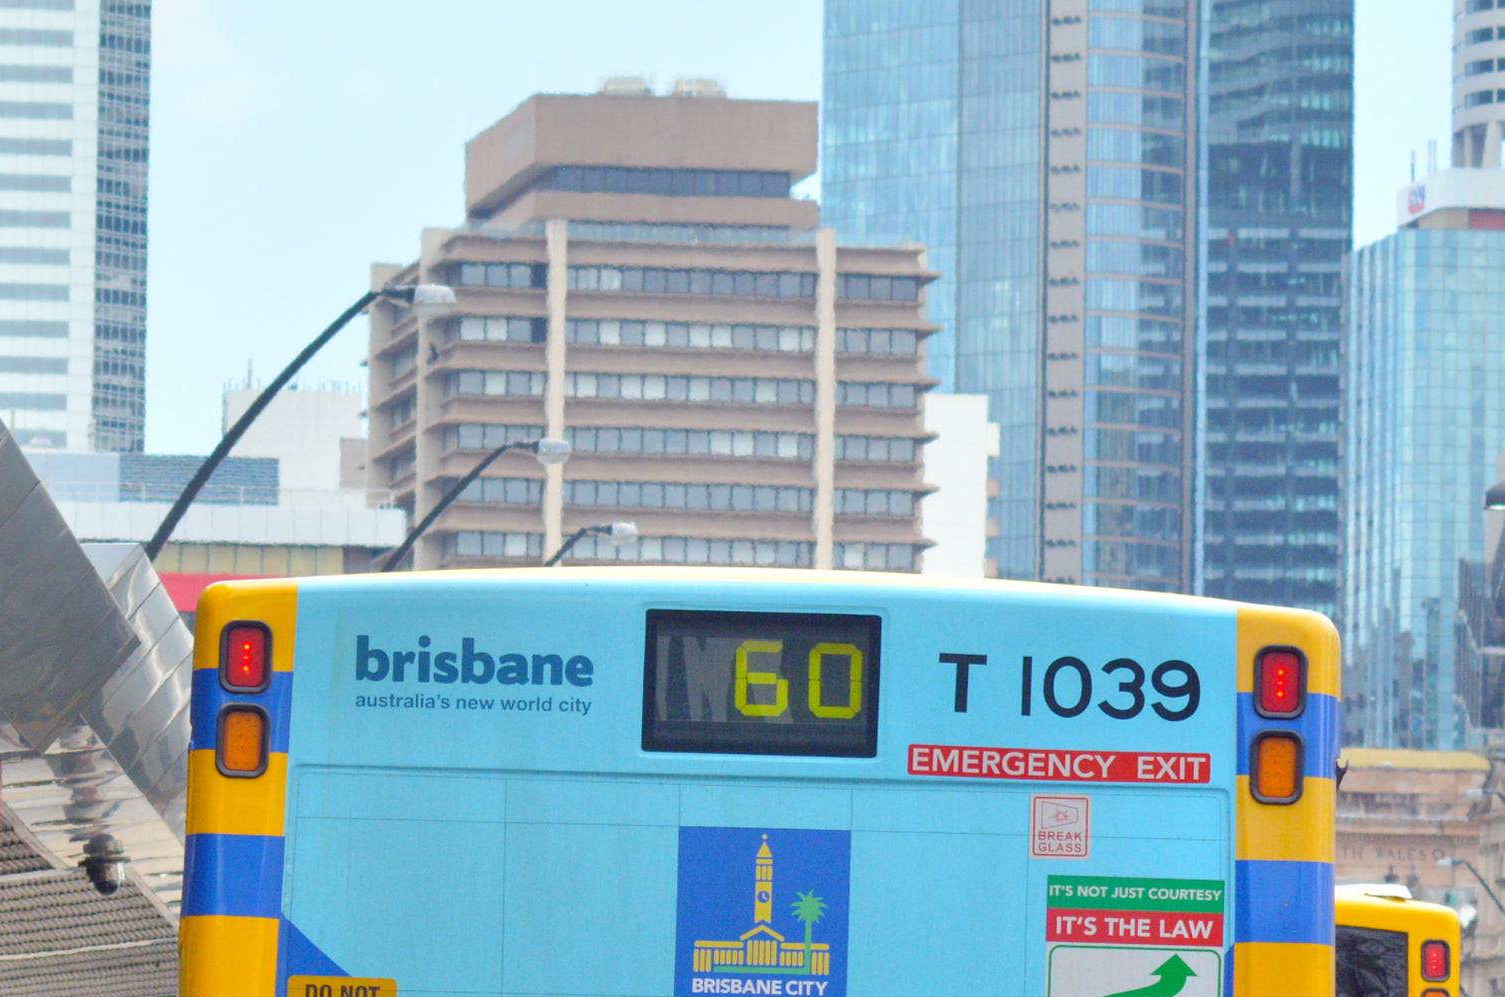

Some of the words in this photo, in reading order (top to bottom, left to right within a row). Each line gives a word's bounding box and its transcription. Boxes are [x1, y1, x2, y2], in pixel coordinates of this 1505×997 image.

[355, 634, 594, 687] brisbane
[734, 640, 863, 719] 60
[938, 652, 988, 713] T
[1021, 656, 1201, 722] 1039
[355, 693, 450, 710] australia's
[455, 699, 494, 711] new
[500, 696, 552, 712] world
[558, 697, 592, 716] city
[911, 748, 1116, 778] EMERGENCY
[1136, 756, 1207, 780] EXIT
[1037, 831, 1083, 842] BREAK
[1037, 842, 1083, 854] GLASS
[1049, 885, 1074, 897] IT'S
[1077, 886, 1108, 898] NOT
[1111, 887, 1145, 899] JUST
[1148, 888, 1222, 901] COURTESY
[1056, 916, 1097, 936] IT'S
[1104, 917, 1151, 937] THE
[1159, 919, 1214, 939] LAW
[692, 978, 783, 995] BRISBANE
[785, 980, 829, 996] CITY
